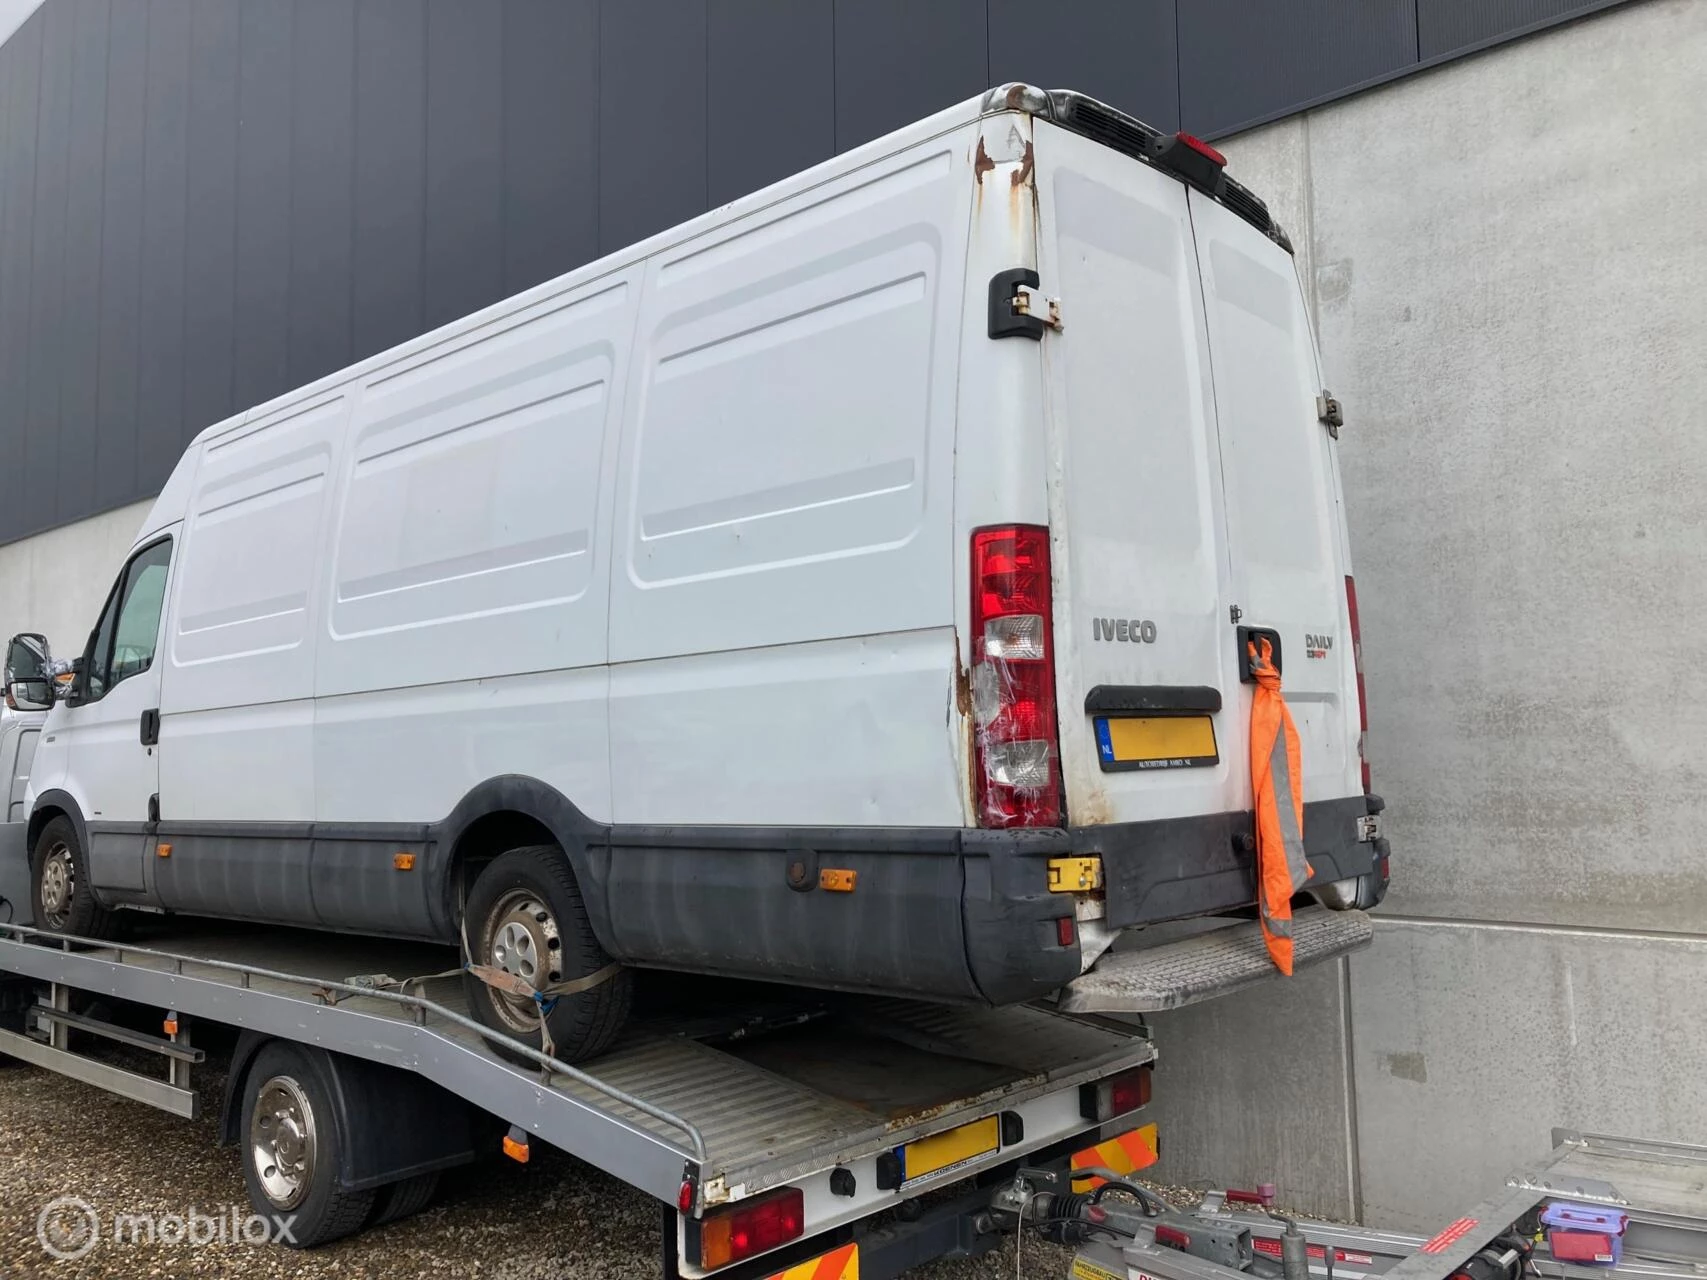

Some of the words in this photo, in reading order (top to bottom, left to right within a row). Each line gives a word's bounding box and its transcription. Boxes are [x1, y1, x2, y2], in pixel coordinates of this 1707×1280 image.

[1093, 618, 1157, 643] IVECO
[1305, 633, 1333, 650] DAILY
[1102, 745, 1112, 754] NL
